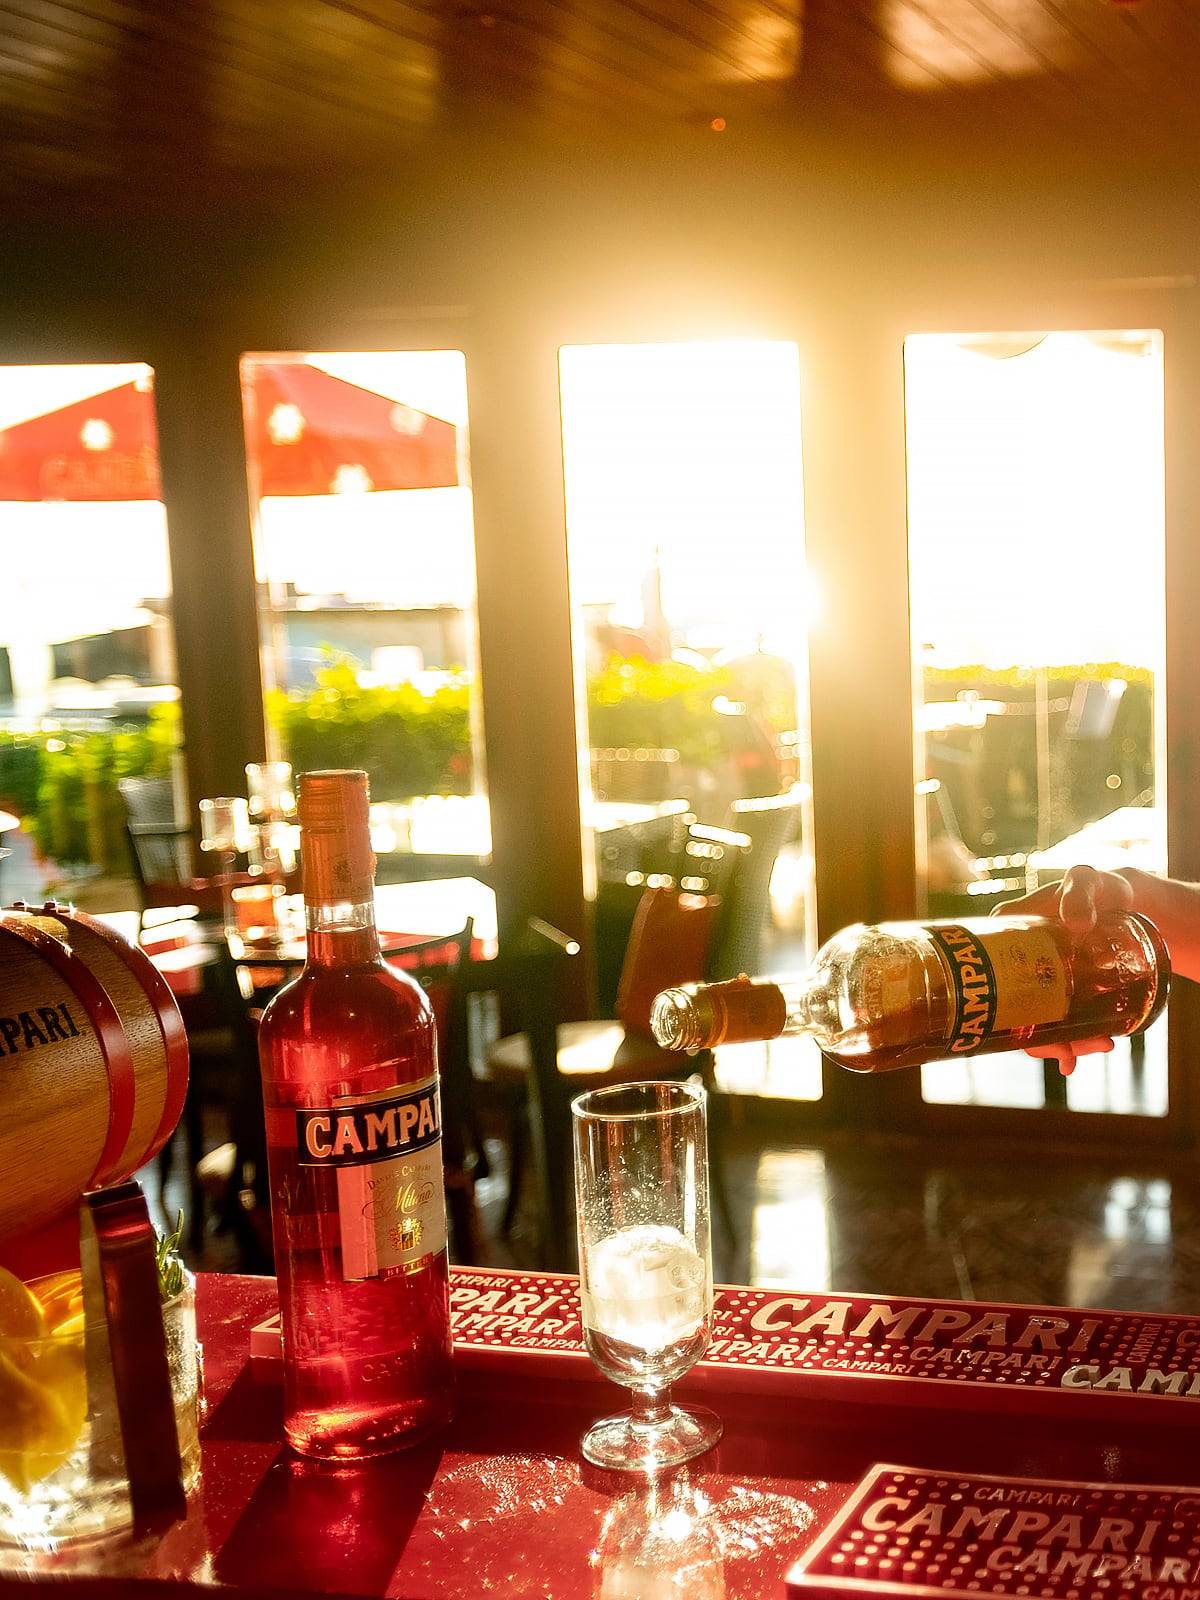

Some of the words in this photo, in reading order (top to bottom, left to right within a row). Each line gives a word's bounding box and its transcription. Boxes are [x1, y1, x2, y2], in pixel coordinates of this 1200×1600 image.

[0, 1003, 80, 1057] PARI
[750, 1297, 1102, 1352] CAMPARI
[1126, 1323, 1162, 1363] CAMPARI
[822, 1358, 915, 1374] CAMPARI
[910, 1346, 1063, 1370] CAMPARI
[973, 1486, 1082, 1506] CAMPARI
[861, 1497, 1161, 1553] CAMPARI
